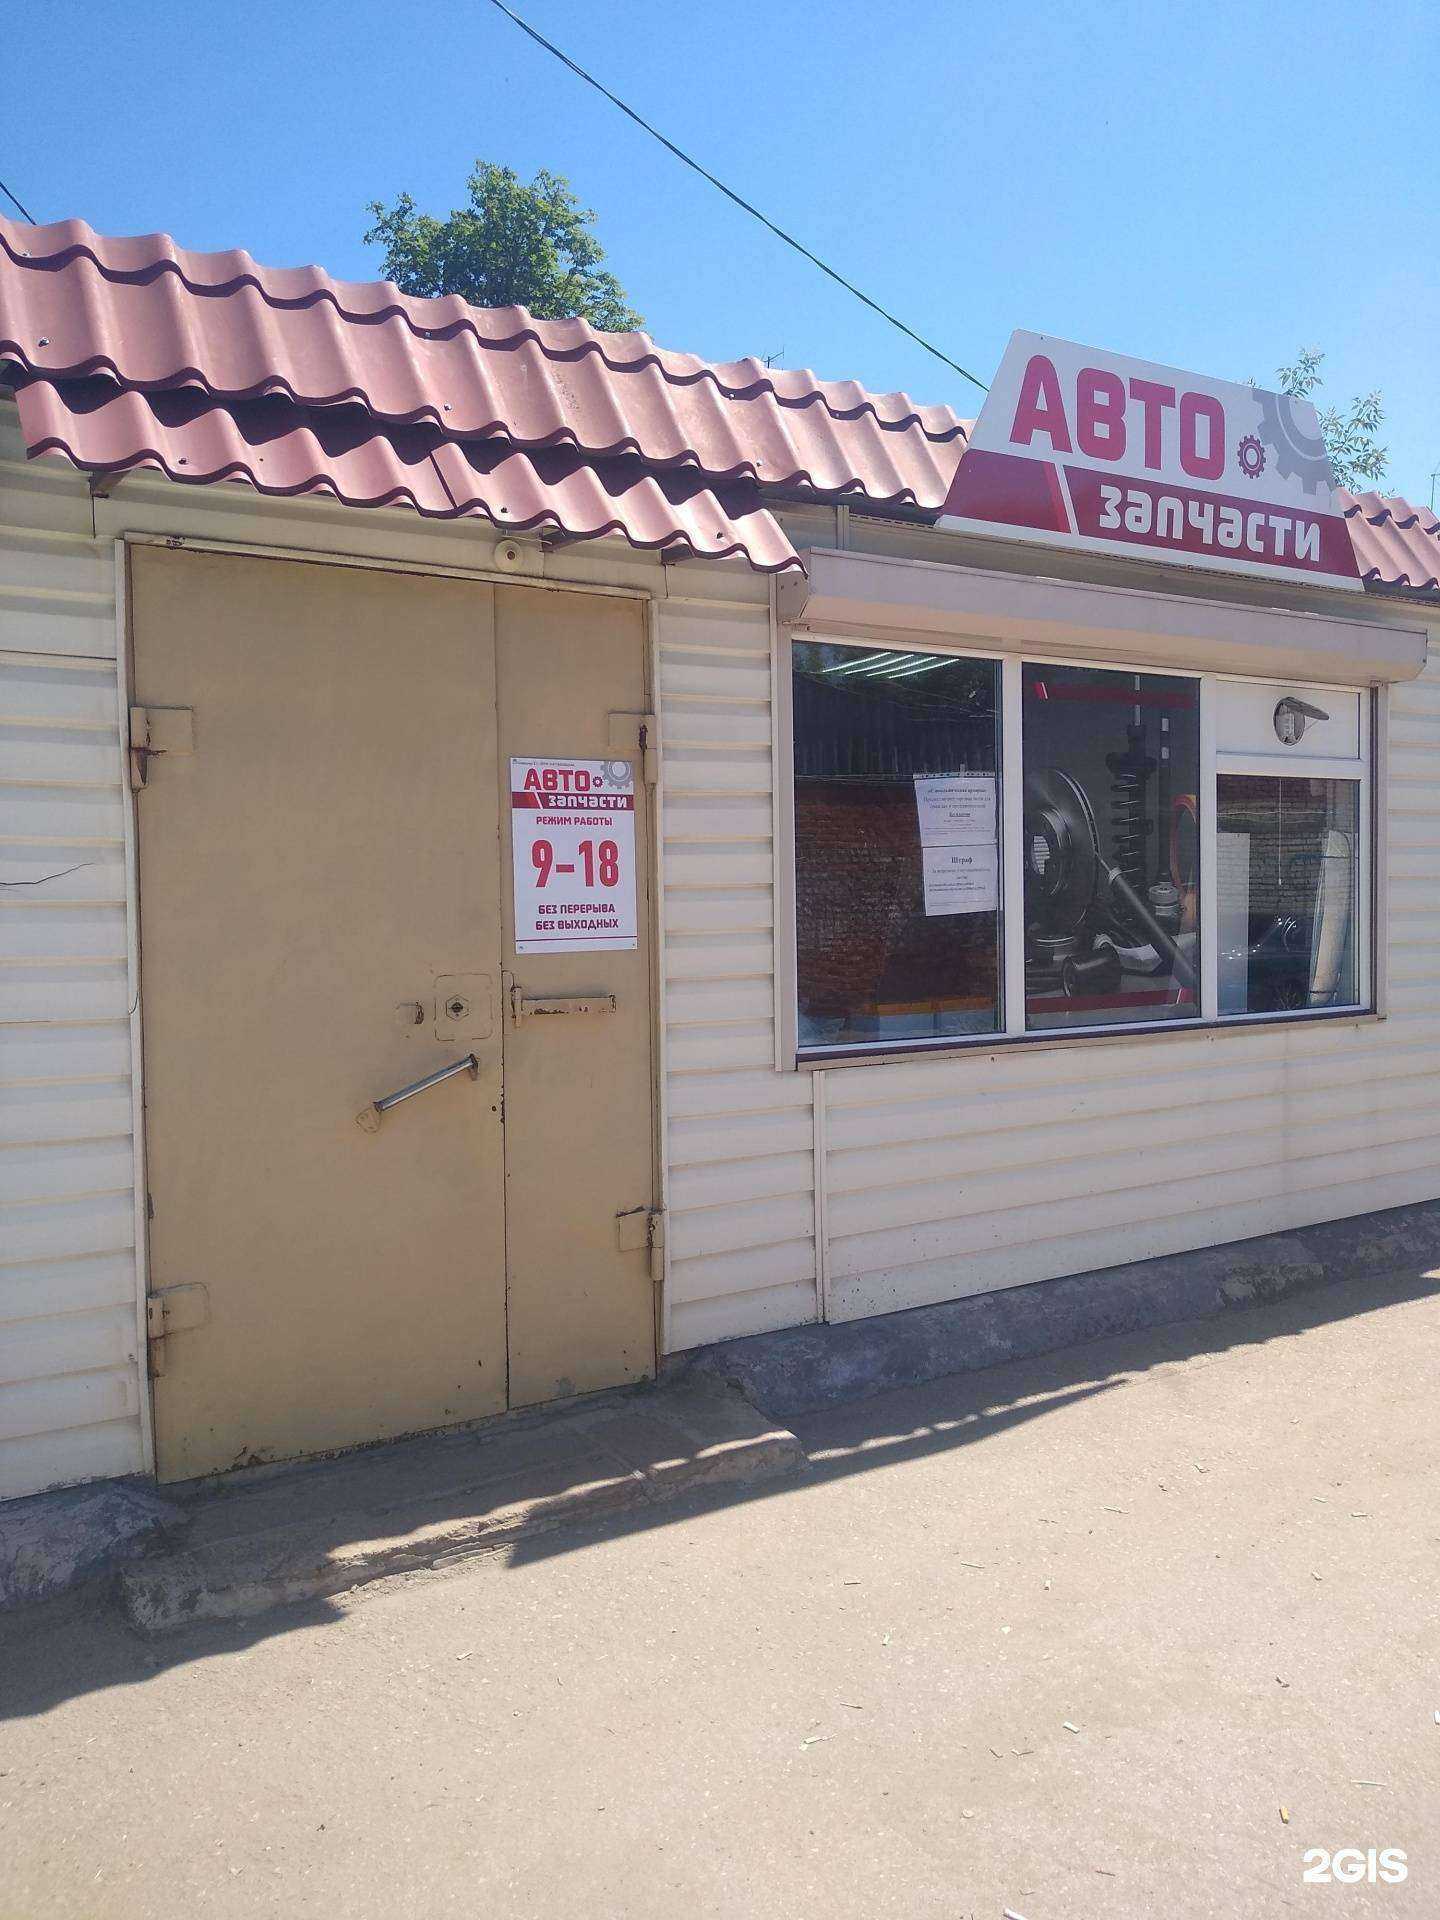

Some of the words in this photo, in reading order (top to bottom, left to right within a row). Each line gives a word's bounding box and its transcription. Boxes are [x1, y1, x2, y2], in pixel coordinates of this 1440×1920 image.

[1009, 354, 1226, 481] АВТО
[1098, 484, 1322, 563] запчасти
[524, 768, 591, 792] АВТО
[548, 794, 627, 809] запчасти
[536, 816, 572, 826] РЕЖИМ
[574, 816, 613, 827] РАБОТЫ
[538, 904, 556, 915] БЕЗ
[560, 903, 615, 914] ПЕРЕРЫВА
[535, 920, 555, 931] БЕЗ
[557, 919, 619, 931] ВЫХОДНЫХ
